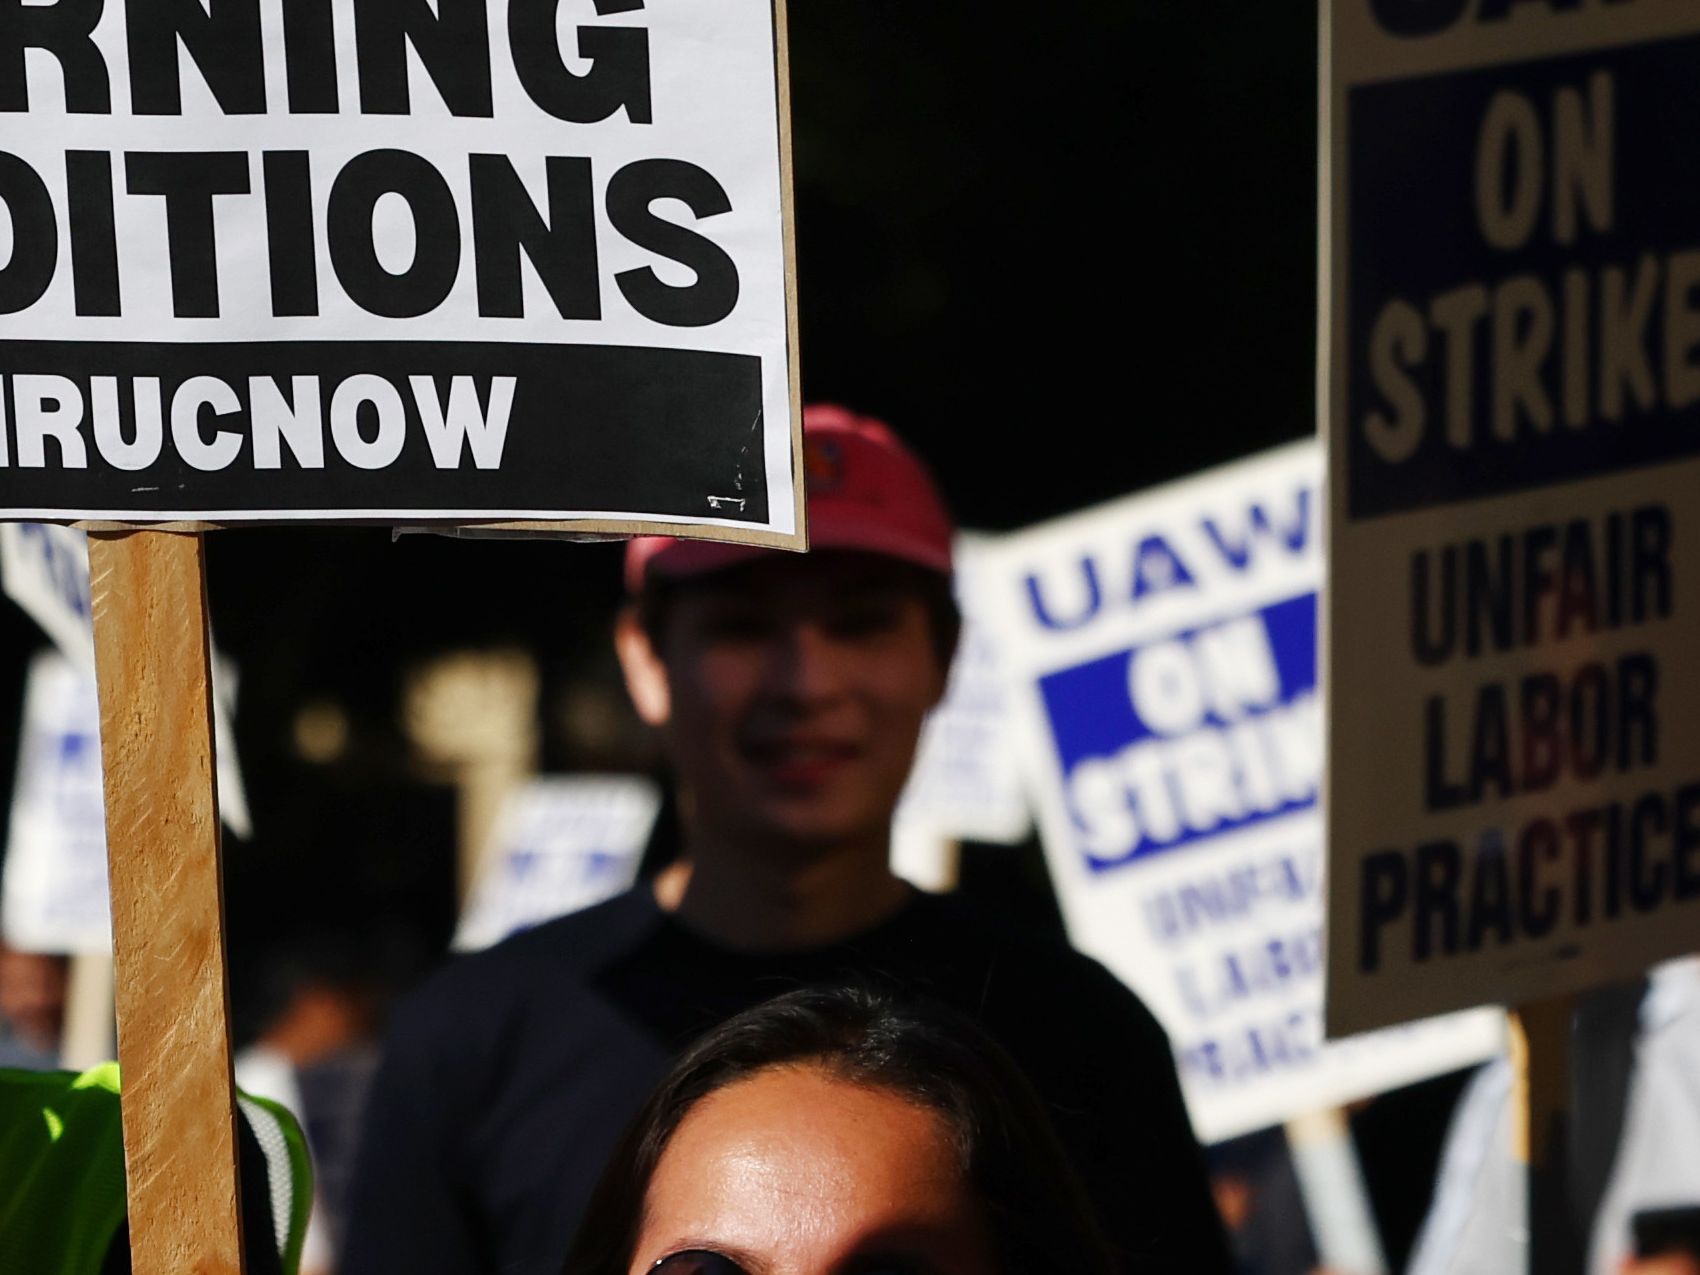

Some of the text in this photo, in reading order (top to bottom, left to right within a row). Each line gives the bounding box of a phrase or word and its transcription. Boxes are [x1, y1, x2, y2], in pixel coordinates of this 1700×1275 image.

[1475, 69, 1615, 250] ON
[1024, 487, 1318, 631] UAW
[1410, 504, 1674, 666] UNFAIR
[1127, 607, 1283, 735] ON
[1424, 651, 1659, 815] LABOR
